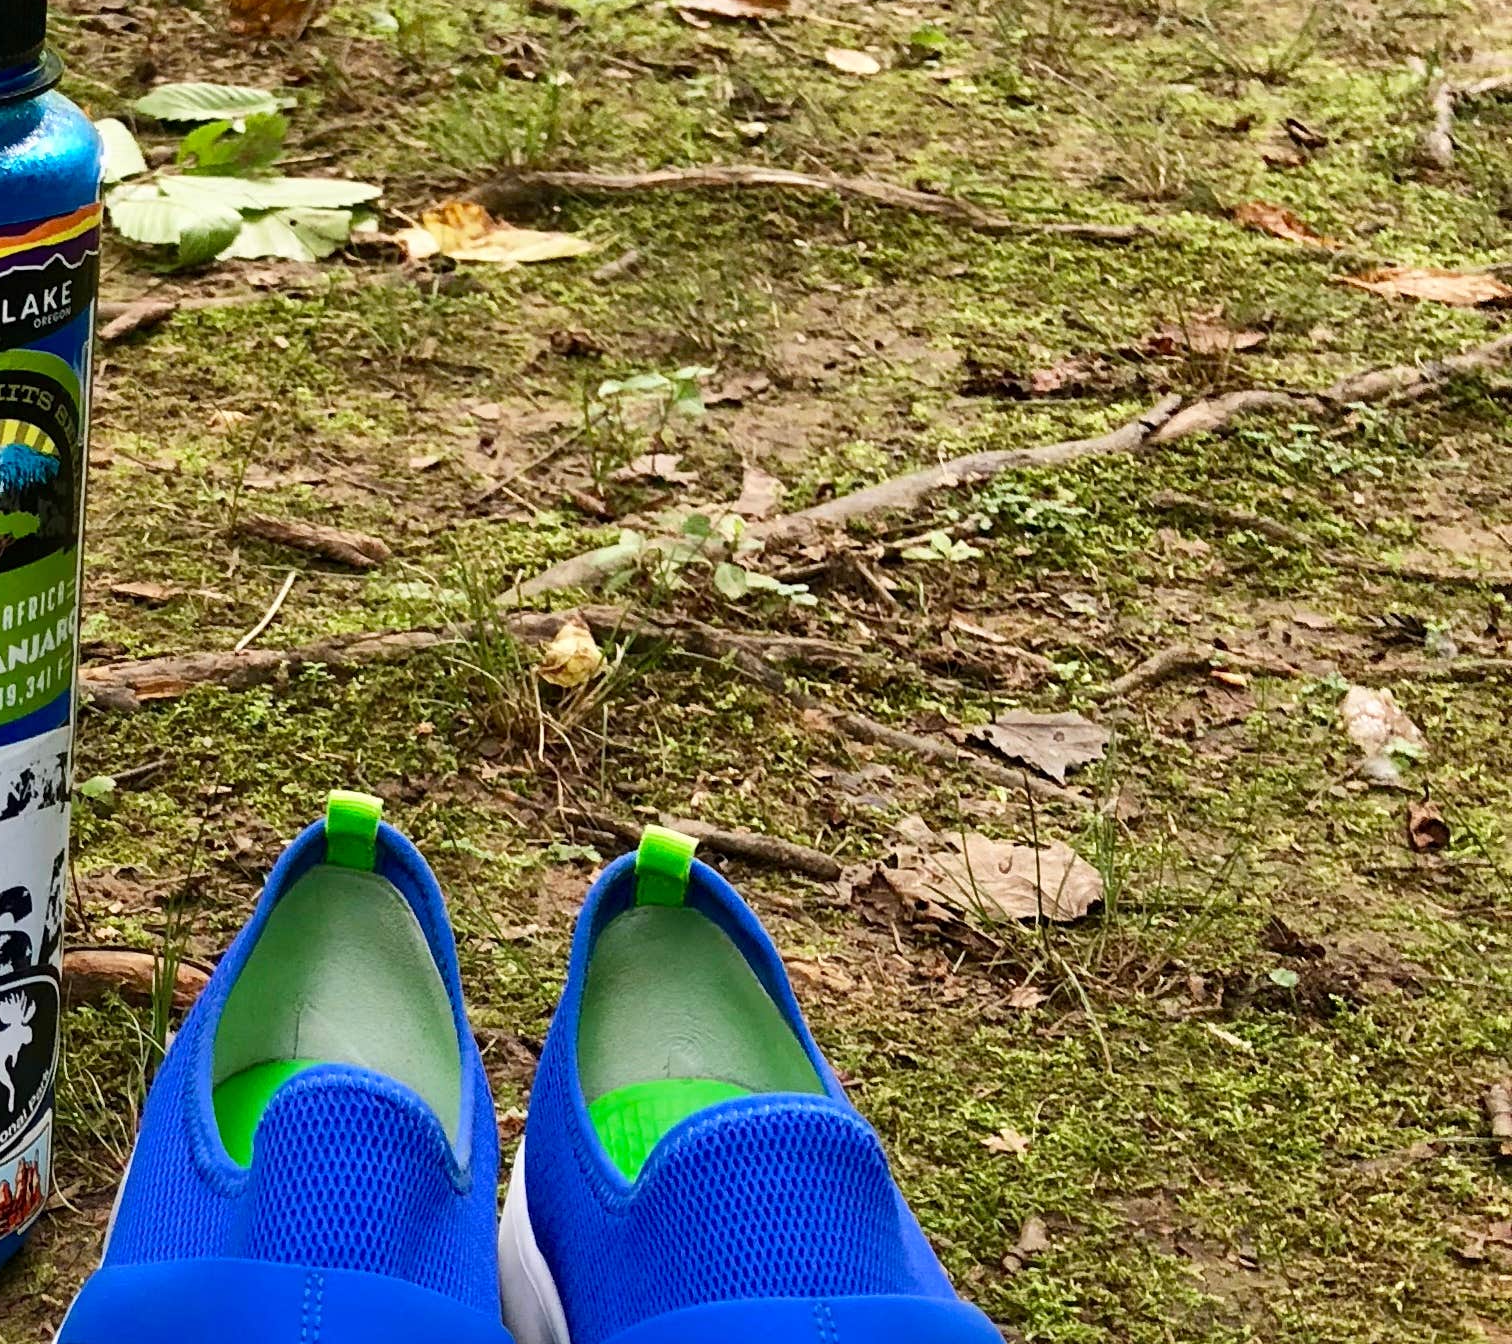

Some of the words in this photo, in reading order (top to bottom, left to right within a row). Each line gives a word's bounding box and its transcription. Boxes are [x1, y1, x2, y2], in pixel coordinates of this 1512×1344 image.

[1, 279, 73, 324] LAKE
[33, 307, 72, 329] OREGON
[2, 579, 65, 631] AFRICA
